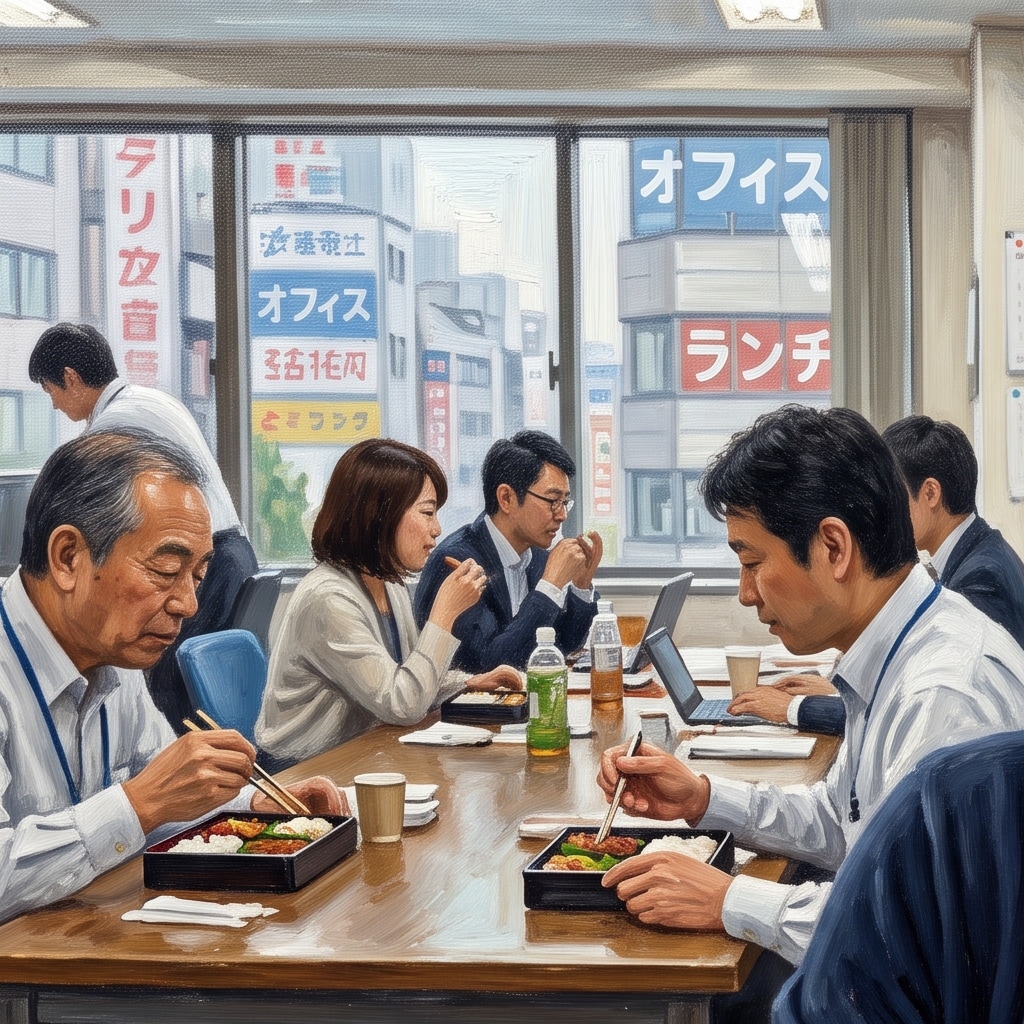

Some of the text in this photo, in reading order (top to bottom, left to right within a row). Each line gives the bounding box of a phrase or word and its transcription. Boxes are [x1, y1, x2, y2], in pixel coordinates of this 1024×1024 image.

[640, 149, 829, 204] オフィス
[258, 284, 371, 323] オフィス
[687, 329, 831, 383] ランチ
